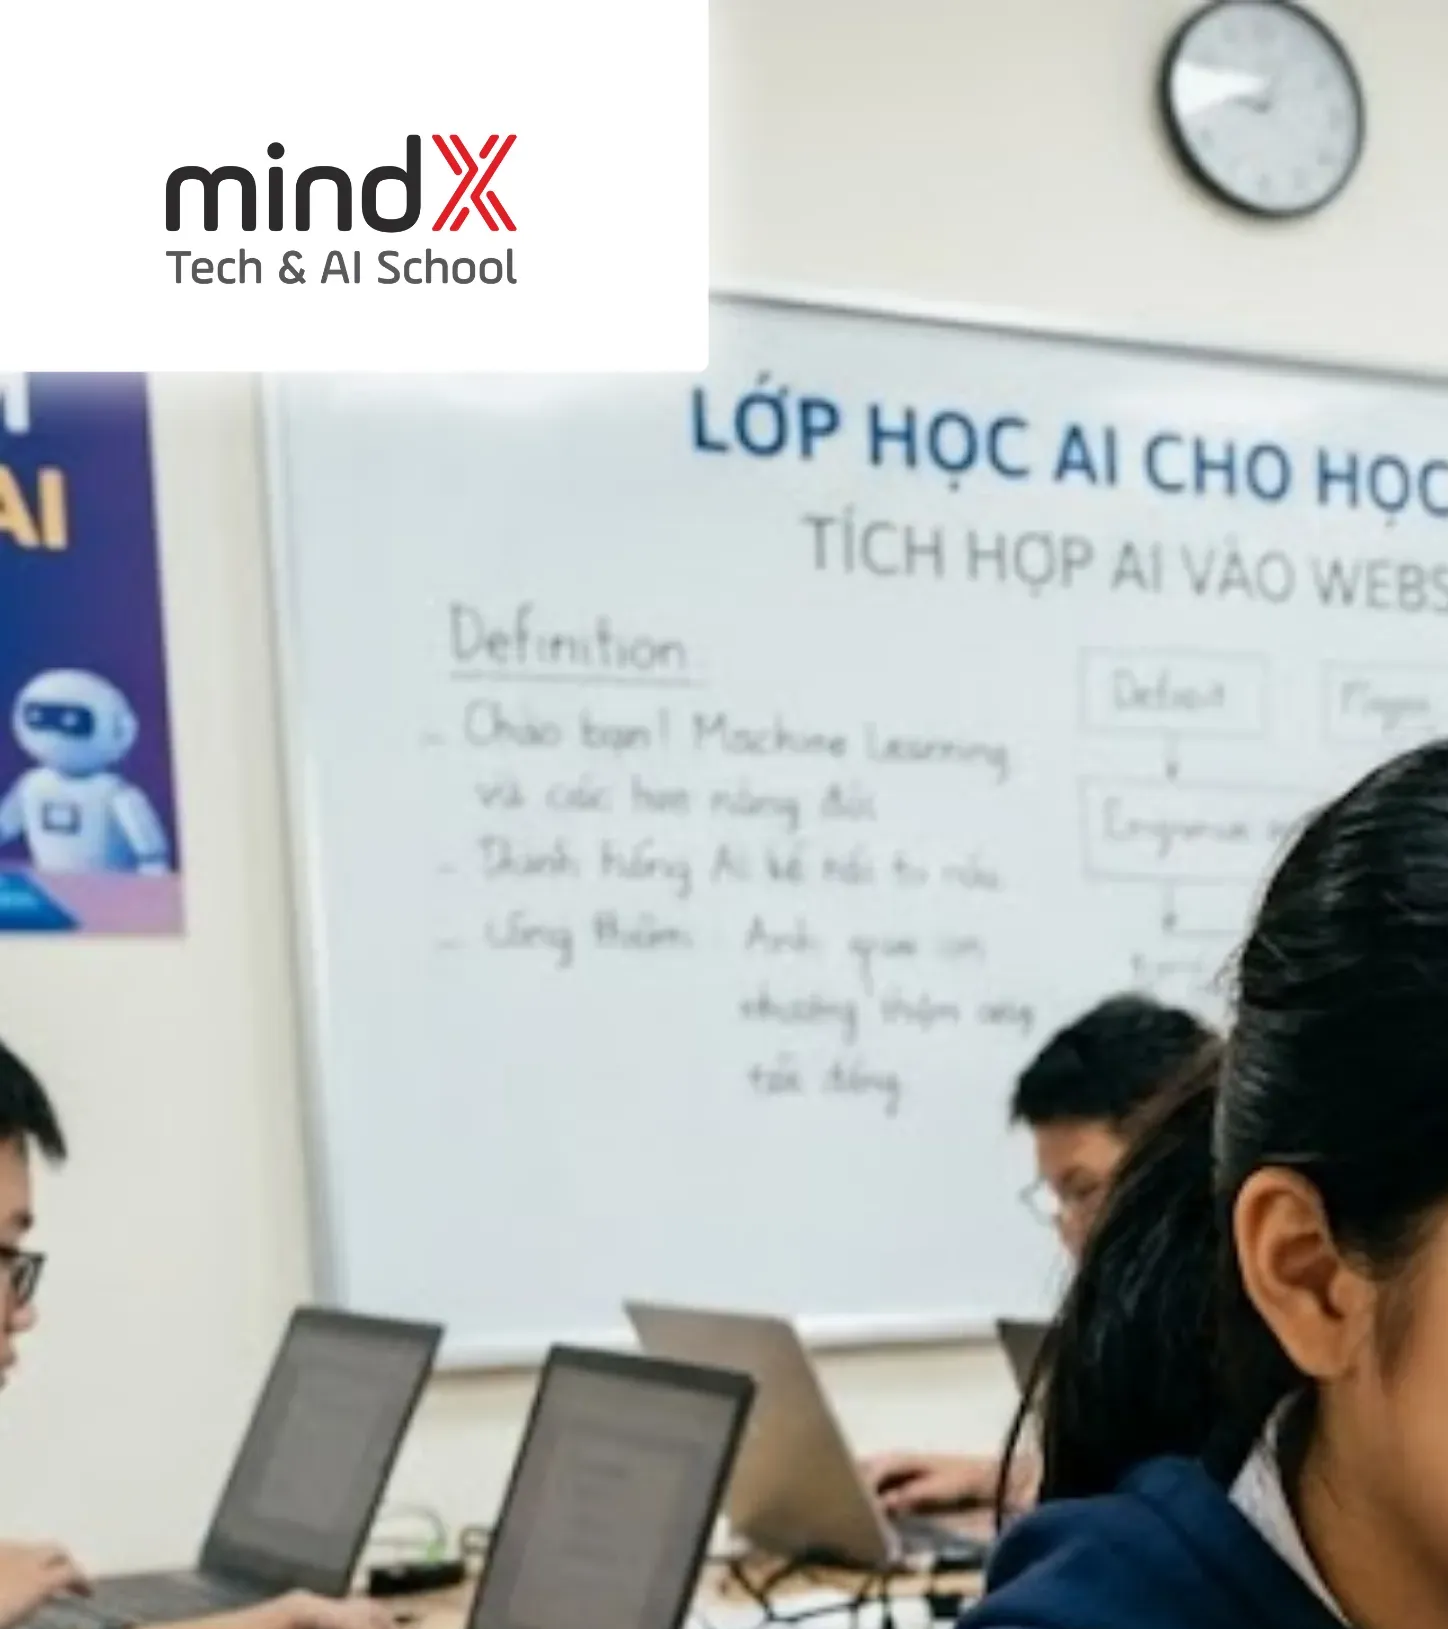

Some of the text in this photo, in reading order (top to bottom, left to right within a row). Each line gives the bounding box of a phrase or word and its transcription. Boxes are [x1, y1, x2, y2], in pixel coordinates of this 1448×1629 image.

[692, 370, 840, 460] LỚP
[868, 404, 1029, 489] HỌC
[1054, 424, 1116, 485] AI
[1144, 433, 1291, 503] CHO
[802, 504, 944, 579] TÍCH
[1112, 541, 1161, 589] AI
[450, 603, 685, 670] Definition
[692, 709, 846, 758] Machine
